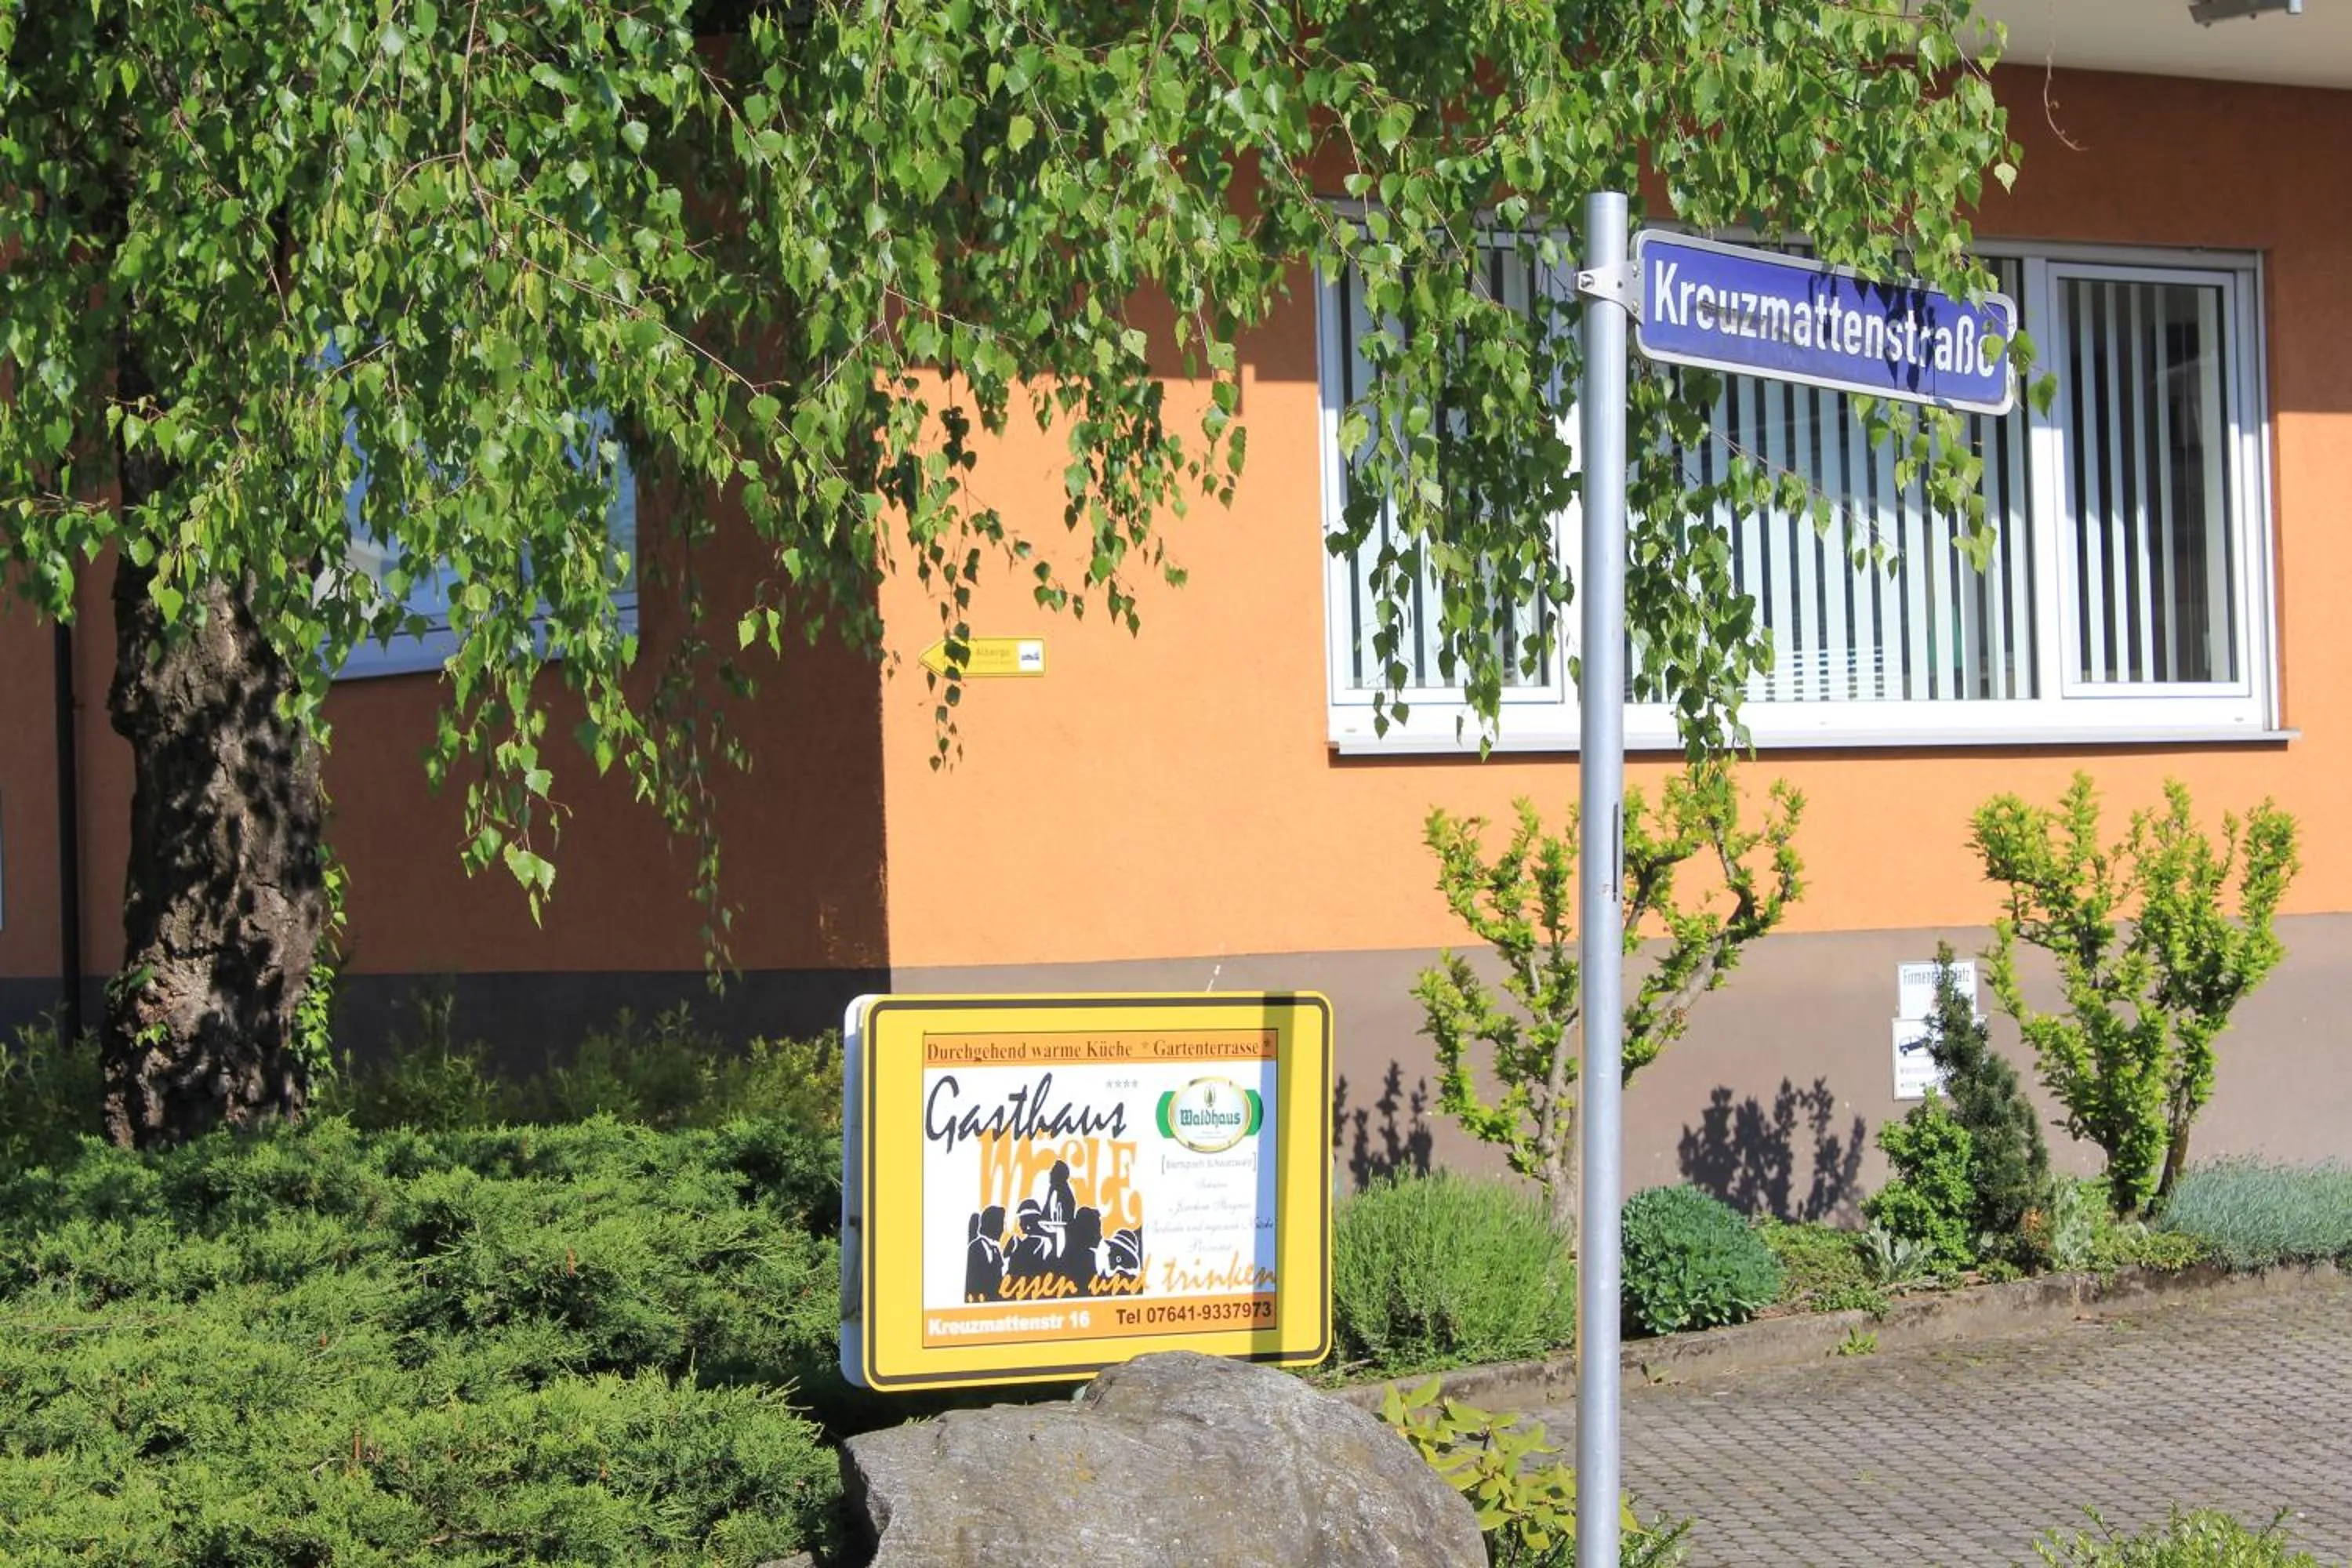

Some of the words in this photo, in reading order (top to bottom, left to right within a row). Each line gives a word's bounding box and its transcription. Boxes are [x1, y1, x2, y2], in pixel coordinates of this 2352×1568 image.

[927, 1042, 1026, 1062] Durchgehend
[1032, 1044, 1082, 1058] warme
[1087, 1040, 1133, 1058] Küche
[1153, 1039, 1259, 1056] Gartenterrasse
[925, 1072, 1127, 1154] Gasthaus
[1180, 1109, 1241, 1128] Waldhaus
[999, 1272, 1079, 1300] essen
[1087, 1253, 1151, 1296] und
[1162, 1250, 1276, 1293] trinken
[927, 1314, 1065, 1336] Kreuzmattenstr
[1069, 1310, 1091, 1329] 16
[1116, 1308, 1141, 1325] Tel
[1146, 1301, 1272, 1323] 07641-9337973
